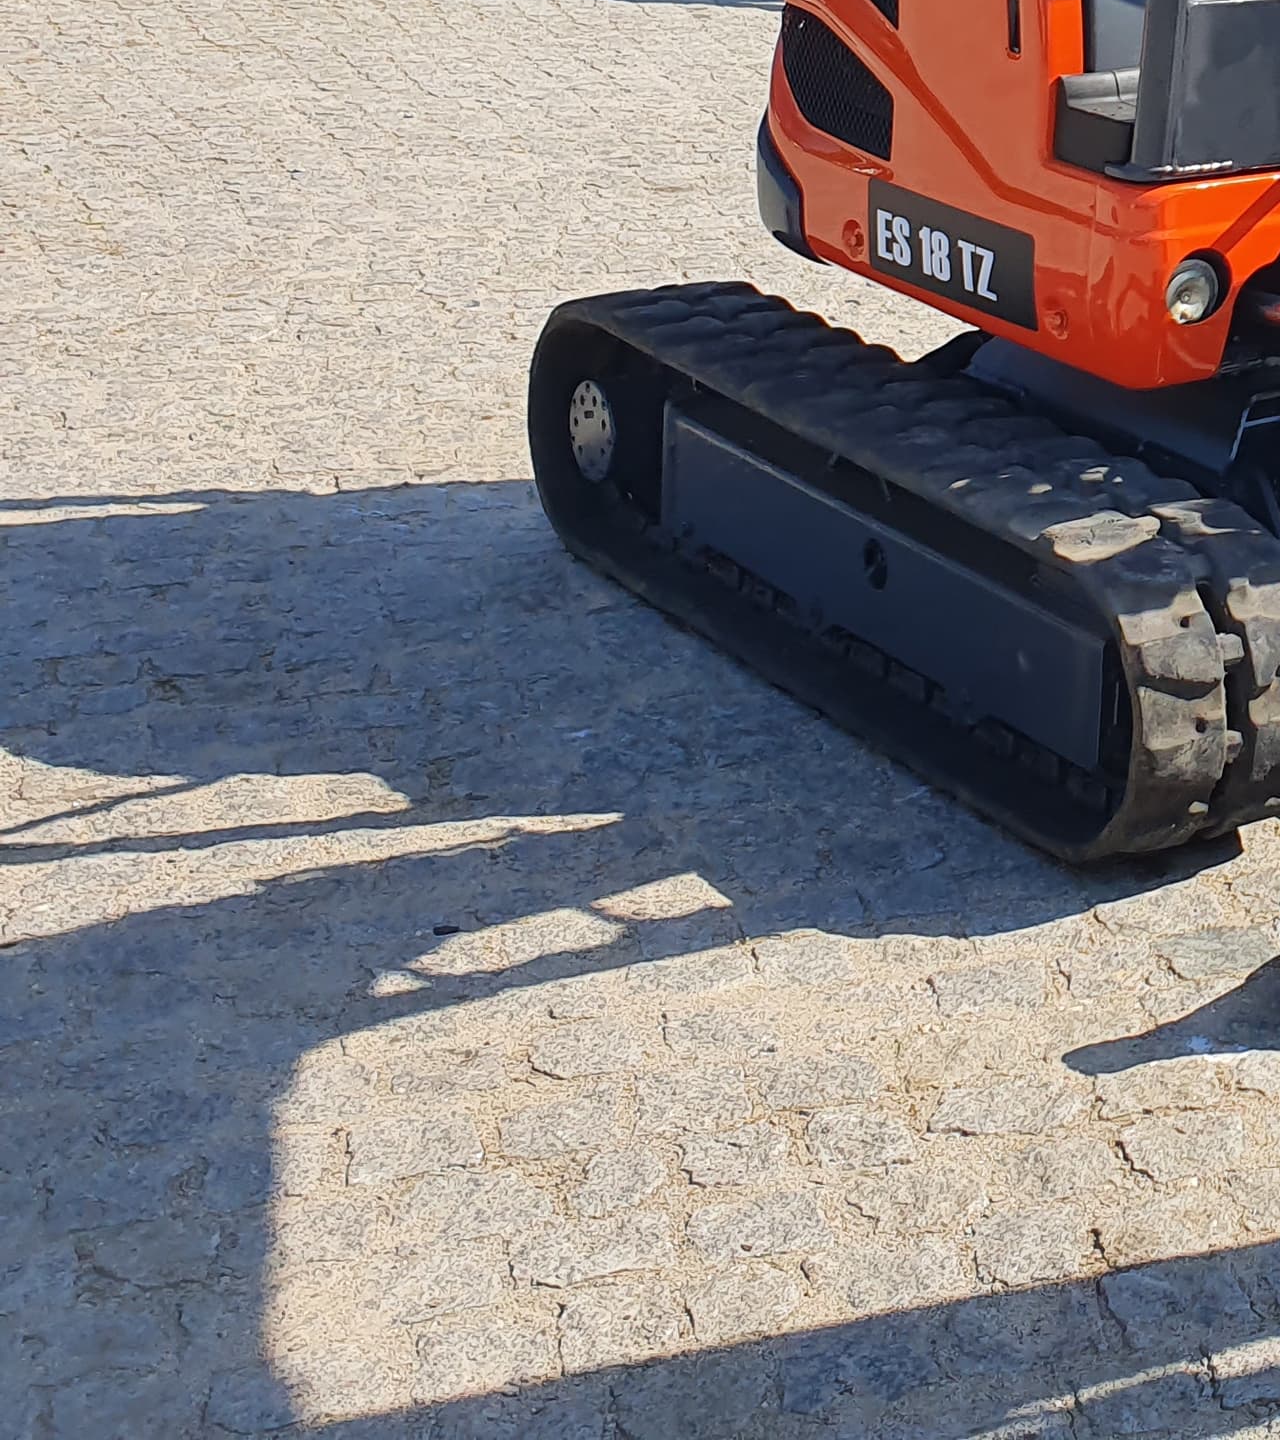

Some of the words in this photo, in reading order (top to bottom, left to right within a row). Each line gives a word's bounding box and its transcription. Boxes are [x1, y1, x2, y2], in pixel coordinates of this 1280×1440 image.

[875, 208, 912, 267] ES
[919, 225, 952, 283] 18
[957, 240, 998, 302] TZ
